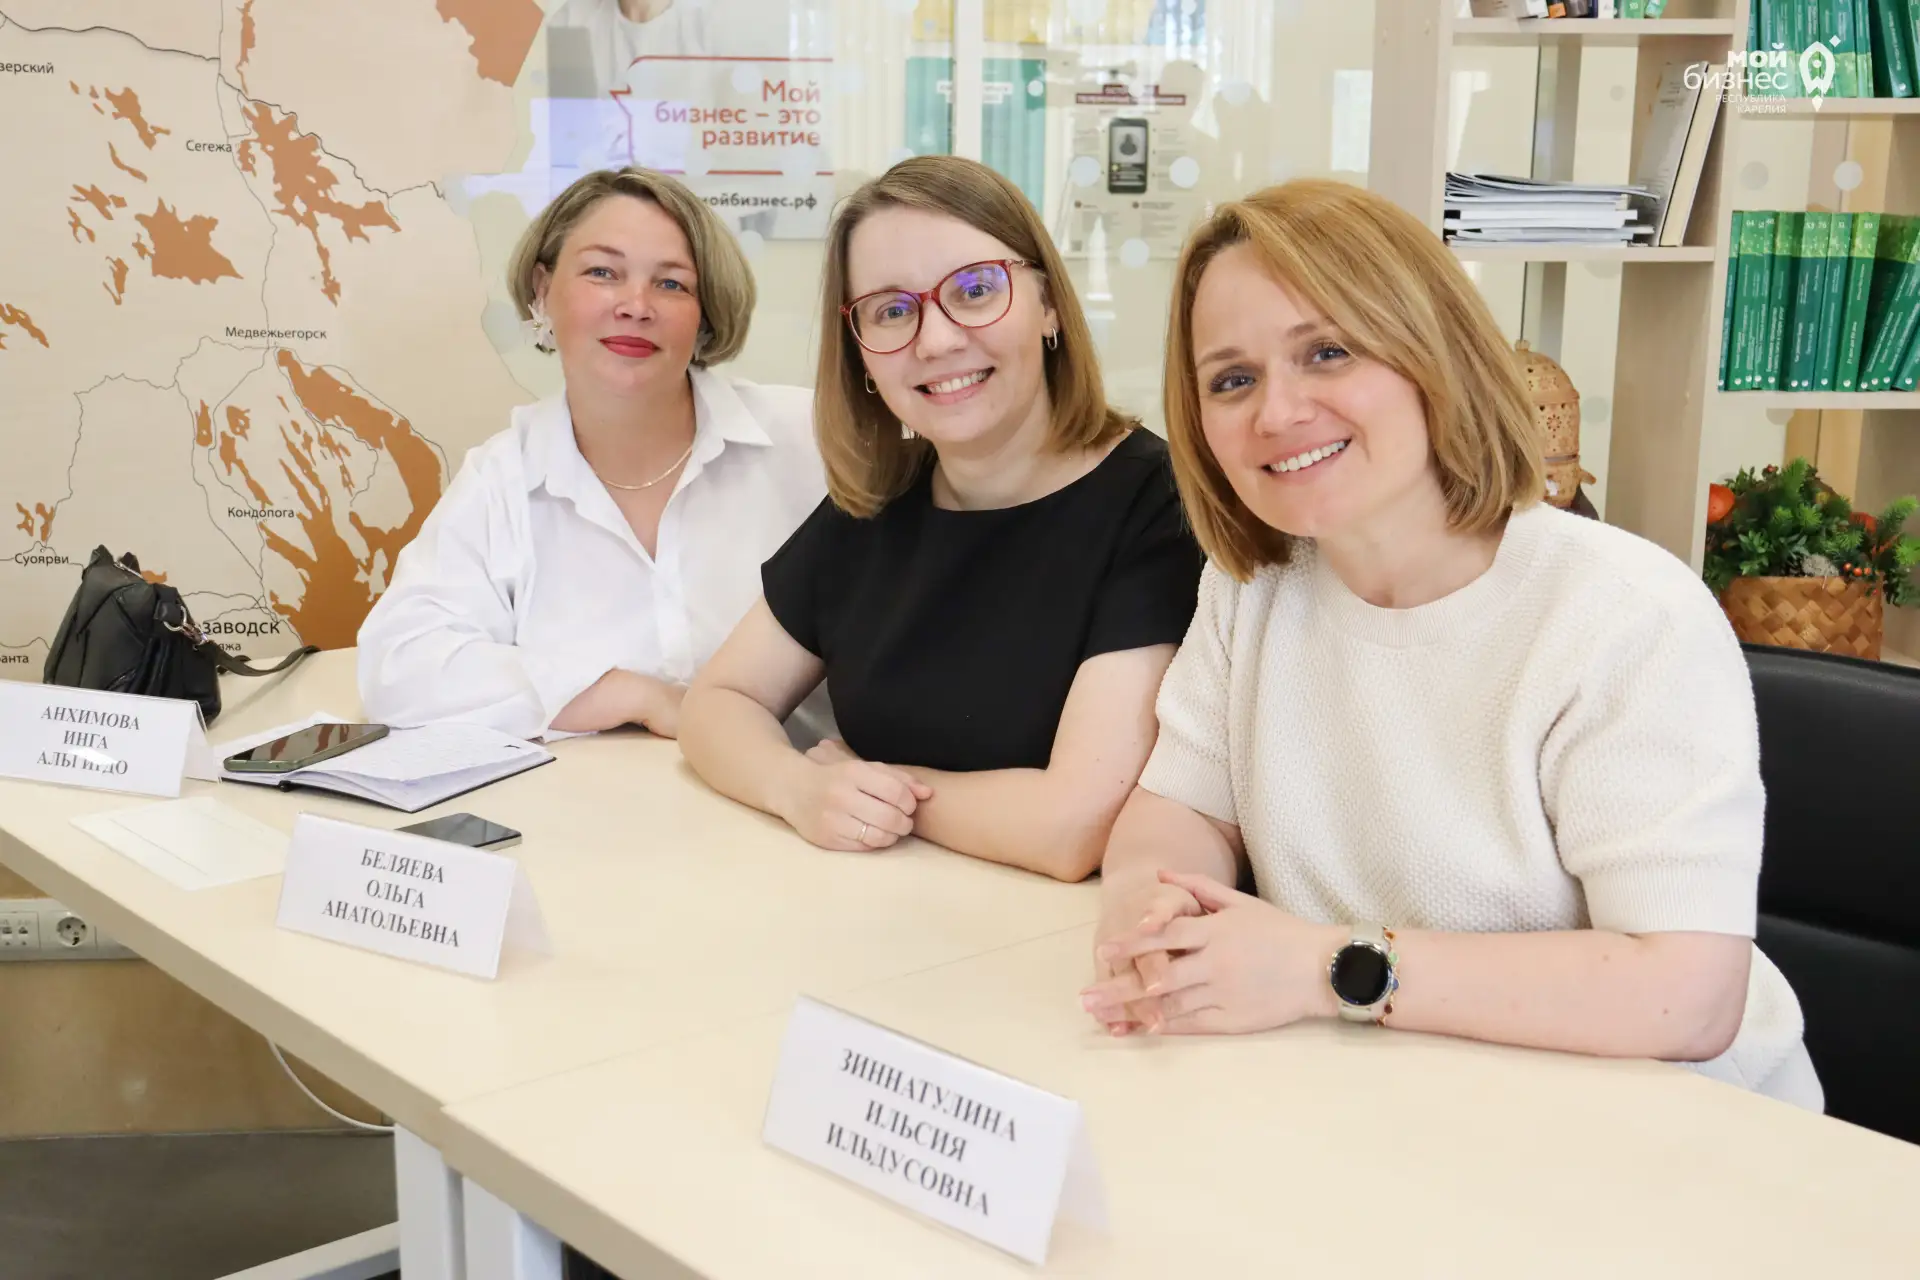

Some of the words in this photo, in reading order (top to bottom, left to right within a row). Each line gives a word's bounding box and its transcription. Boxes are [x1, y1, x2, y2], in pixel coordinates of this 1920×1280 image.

[762, 79, 821, 103] Мой
[655, 101, 748, 124] бизнес
[778, 108, 821, 124] это
[185, 139, 233, 153] Сегежа
[702, 129, 821, 149] развитие
[225, 326, 327, 341] Медвежьегорск
[227, 507, 295, 520] Кондопога
[14, 553, 69, 567] Суоярви
[202, 621, 280, 637] заводск
[0, 655, 29, 664] анта
[41, 705, 140, 731] АНХИМОВА
[63, 730, 108, 750] ИНГА
[360, 848, 444, 883] БЕЛЯЕВА
[366, 879, 424, 909] ОЛЬГА
[321, 900, 459, 947] АНАТОЛЬЕВНА
[838, 1048, 1017, 1142] ЗИННАТУЛИНА
[865, 1099, 967, 1163] ИЛЬСИЯ
[826, 1122, 989, 1216] ИЛЬДУСОВНА
